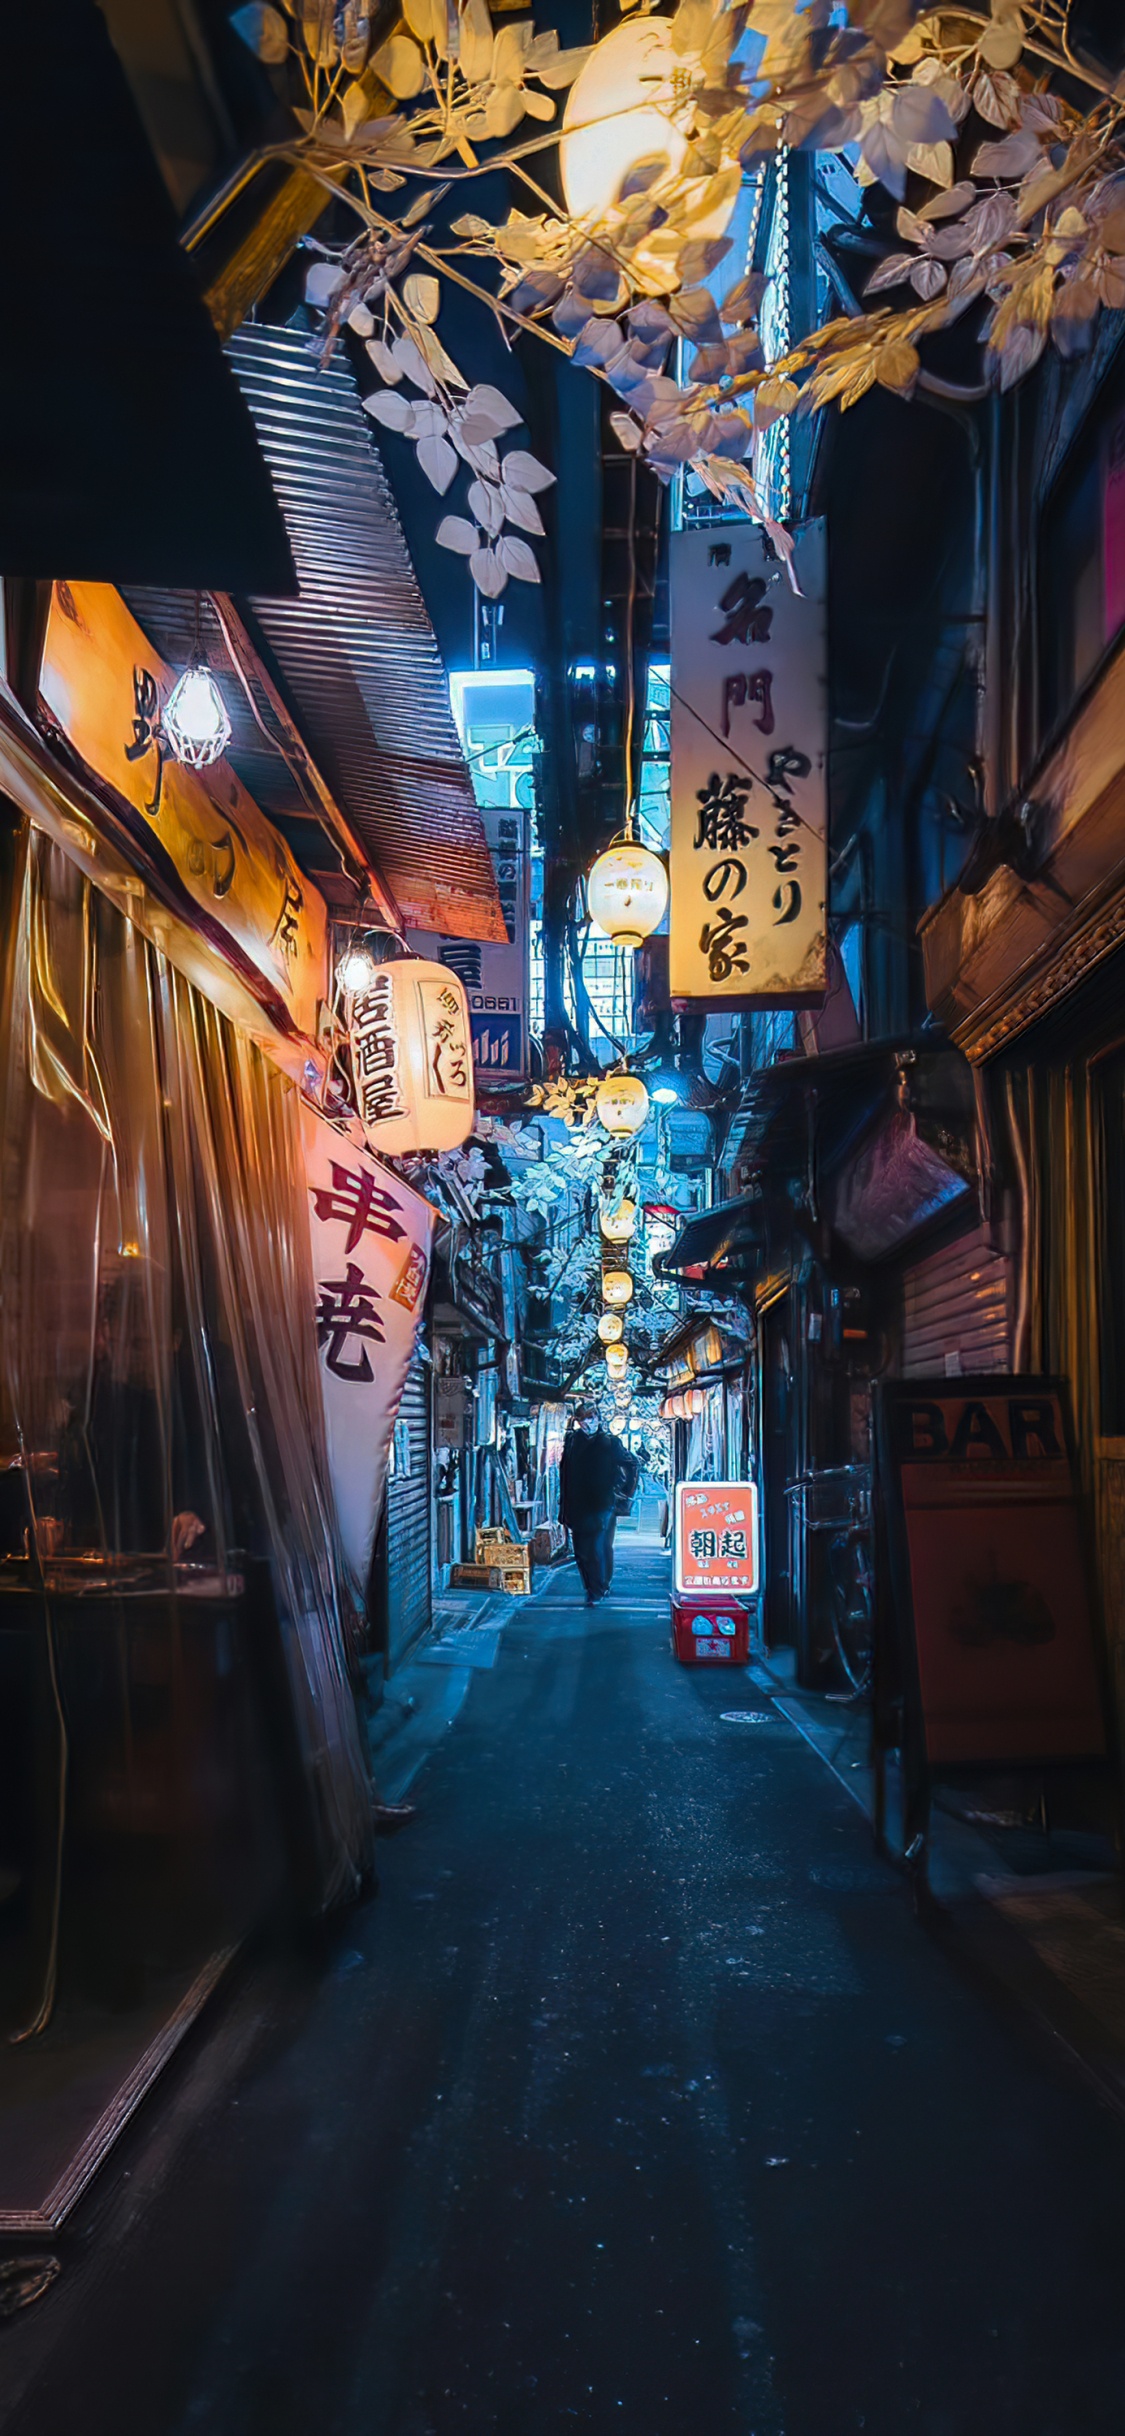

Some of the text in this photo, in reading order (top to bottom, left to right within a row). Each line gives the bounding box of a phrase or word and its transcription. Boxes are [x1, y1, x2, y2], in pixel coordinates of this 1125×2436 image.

[709, 570, 774, 738] 名門
[693, 771, 759, 983] 藤の家
[766, 745, 811, 926] やきとり
[352, 973, 406, 1127] 居酒屋
[896, 1399, 1062, 1458] BAR
[690, 1530, 746, 1558] 朝起
